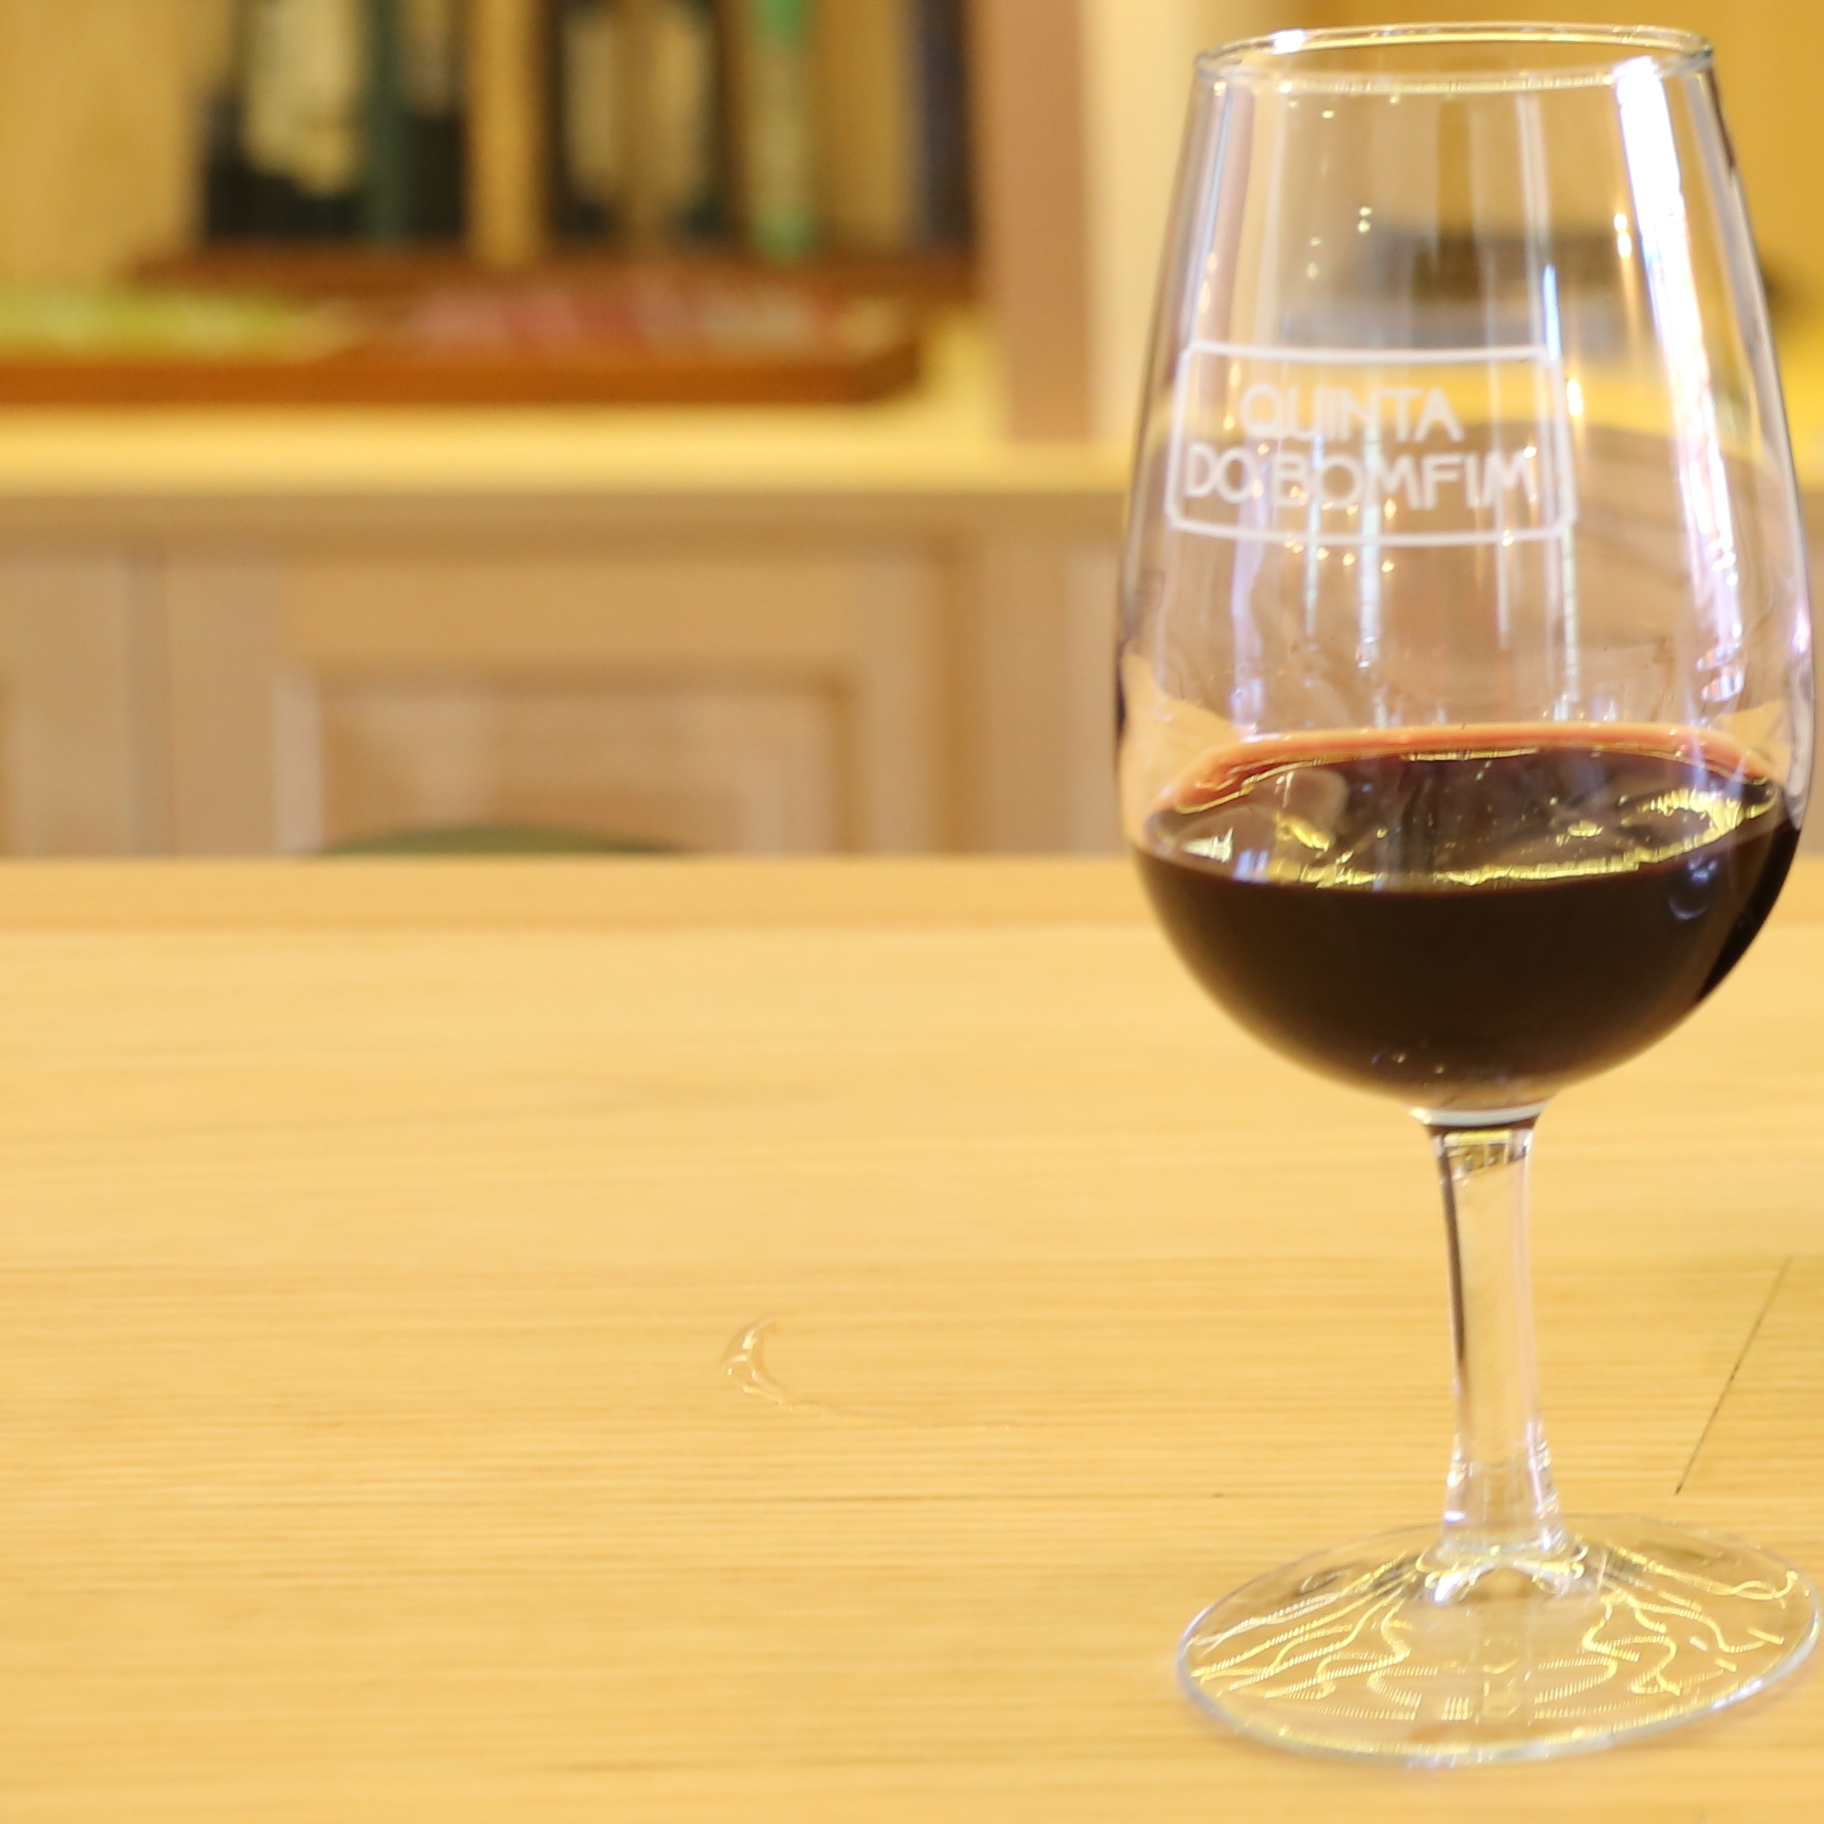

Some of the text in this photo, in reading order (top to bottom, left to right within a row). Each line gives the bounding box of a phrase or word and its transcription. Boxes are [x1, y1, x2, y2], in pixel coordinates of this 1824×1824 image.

[1239, 382, 1466, 444] QUINTA
[1183, 441, 1540, 512] DO BOMFIM
